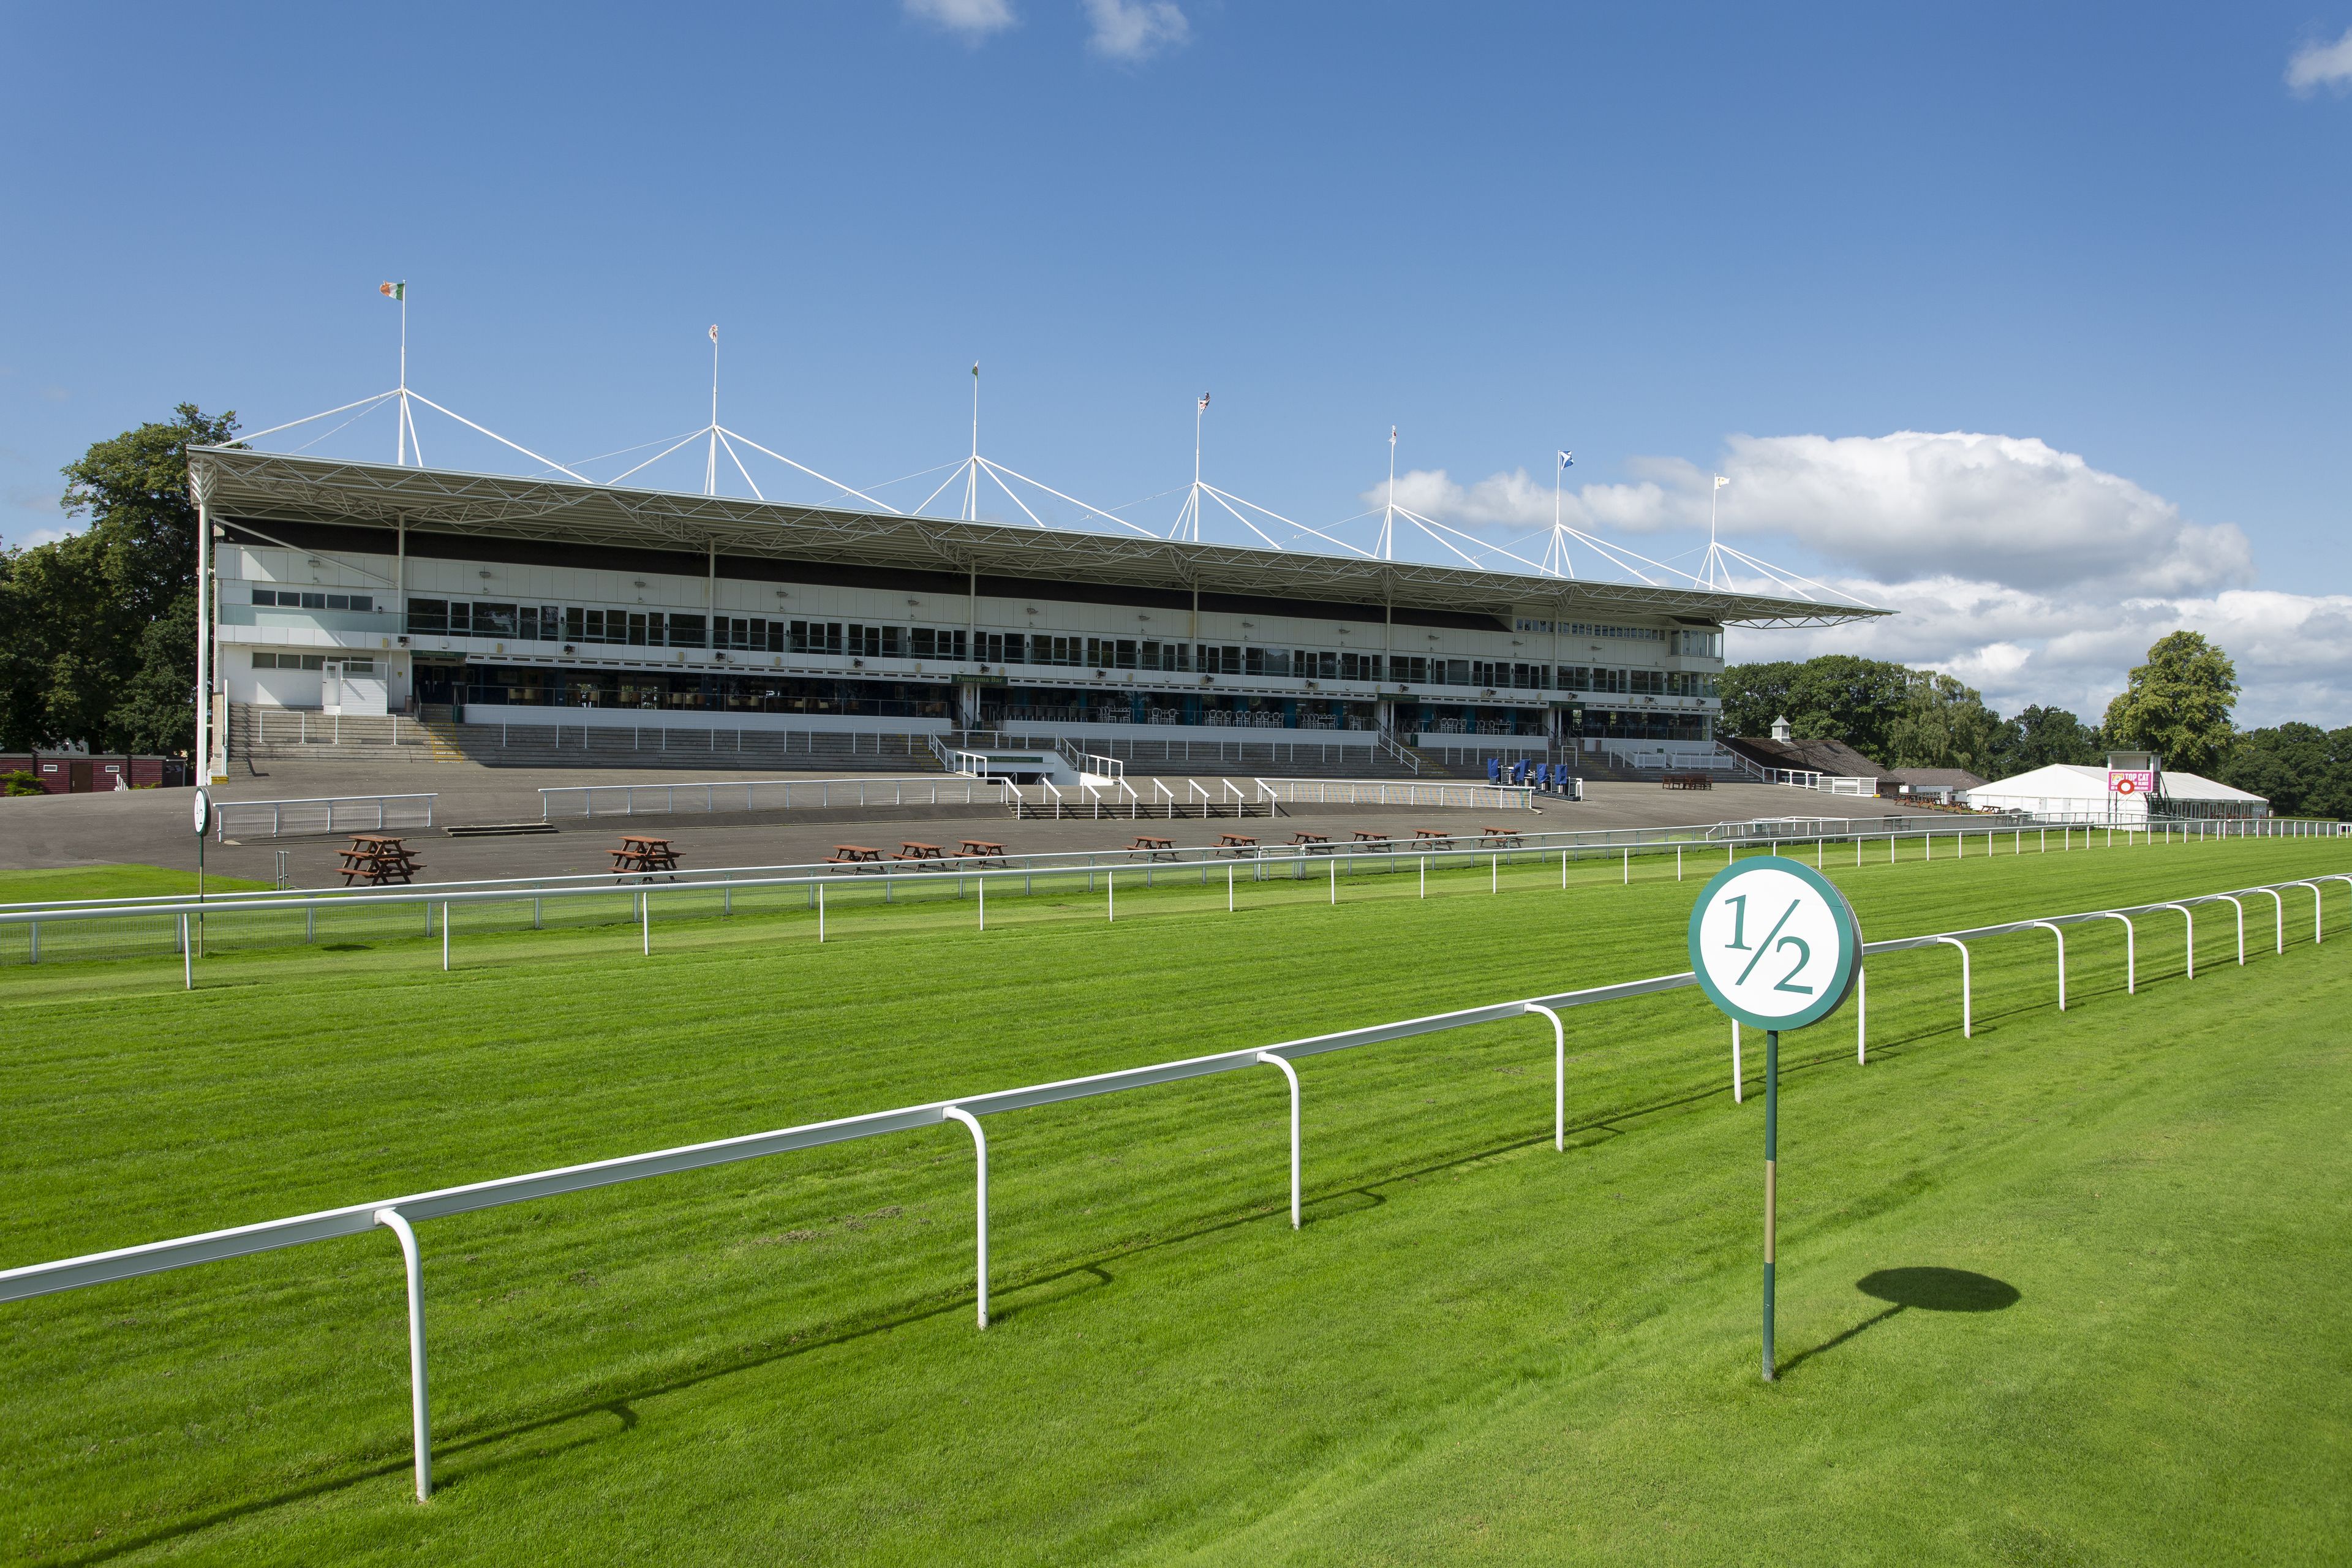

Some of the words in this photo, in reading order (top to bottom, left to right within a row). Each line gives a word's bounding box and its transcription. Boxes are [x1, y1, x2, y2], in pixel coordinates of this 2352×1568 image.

[2125, 773, 2137, 782] TOP
[2138, 773, 2150, 782] CAT
[1725, 894, 1813, 995] 1/2
